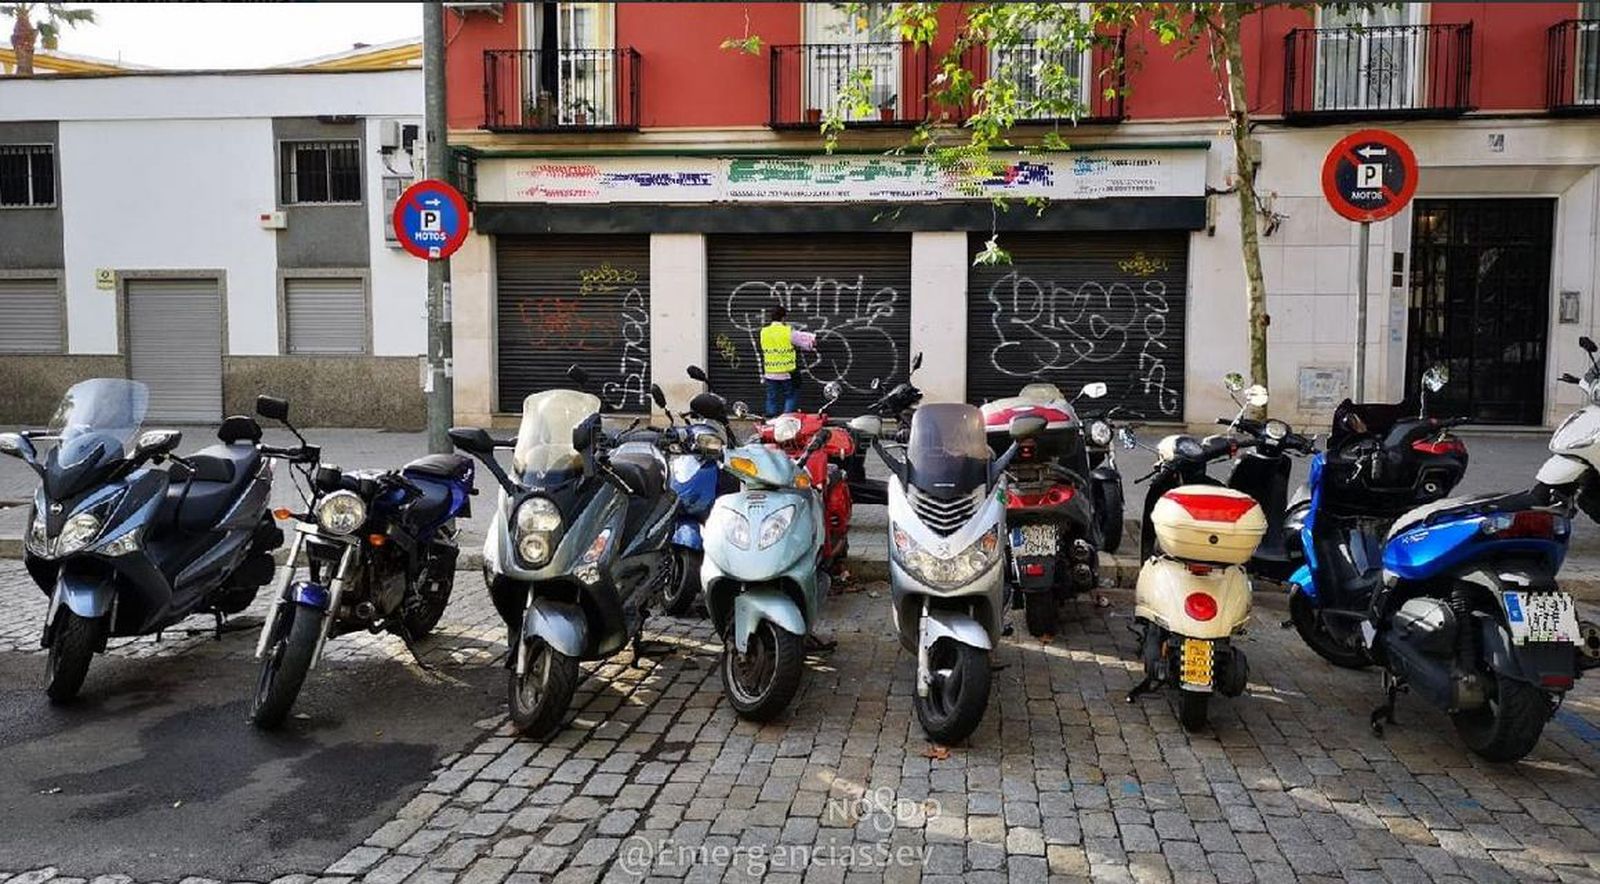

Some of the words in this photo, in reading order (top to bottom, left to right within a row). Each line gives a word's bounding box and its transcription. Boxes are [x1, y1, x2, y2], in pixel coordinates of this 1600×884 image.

[1365, 165, 1376, 186] P
[1351, 191, 1383, 200] MOTOS
[424, 211, 437, 228] P
[414, 231, 447, 241] MOTOS
